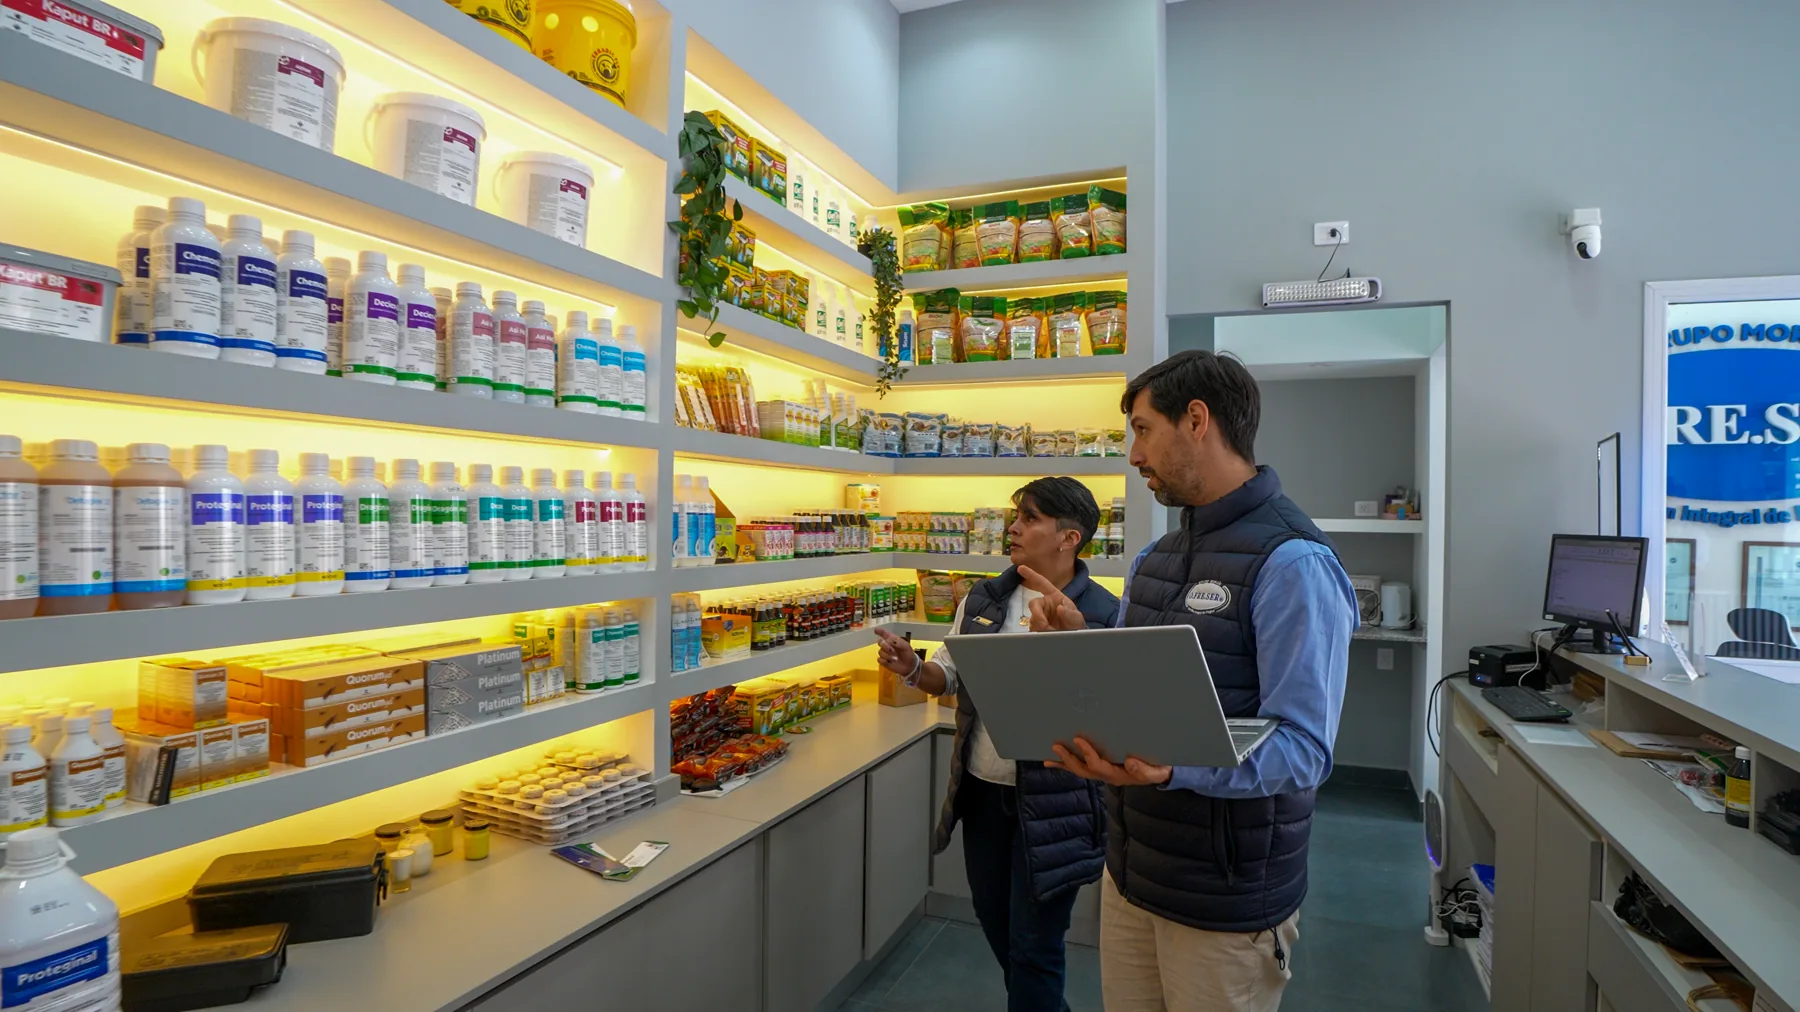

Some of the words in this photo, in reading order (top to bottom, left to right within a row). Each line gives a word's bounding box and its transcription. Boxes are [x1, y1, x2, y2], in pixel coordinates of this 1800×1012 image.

[42, 0, 90, 27] Kaput
[91, 18, 112, 36] BR
[46, 275, 68, 289] BR
[1681, 505, 1761, 528] Integral
[1764, 508, 1792, 524] de
[477, 650, 520, 665] Platinum
[346, 672, 384, 685] Quorum
[478, 673, 521, 689] Platinum
[347, 698, 385, 713] Quorum
[478, 695, 521, 713] Platinum
[347, 725, 385, 741] Quorum
[17, 949, 98, 986] Proteginal
